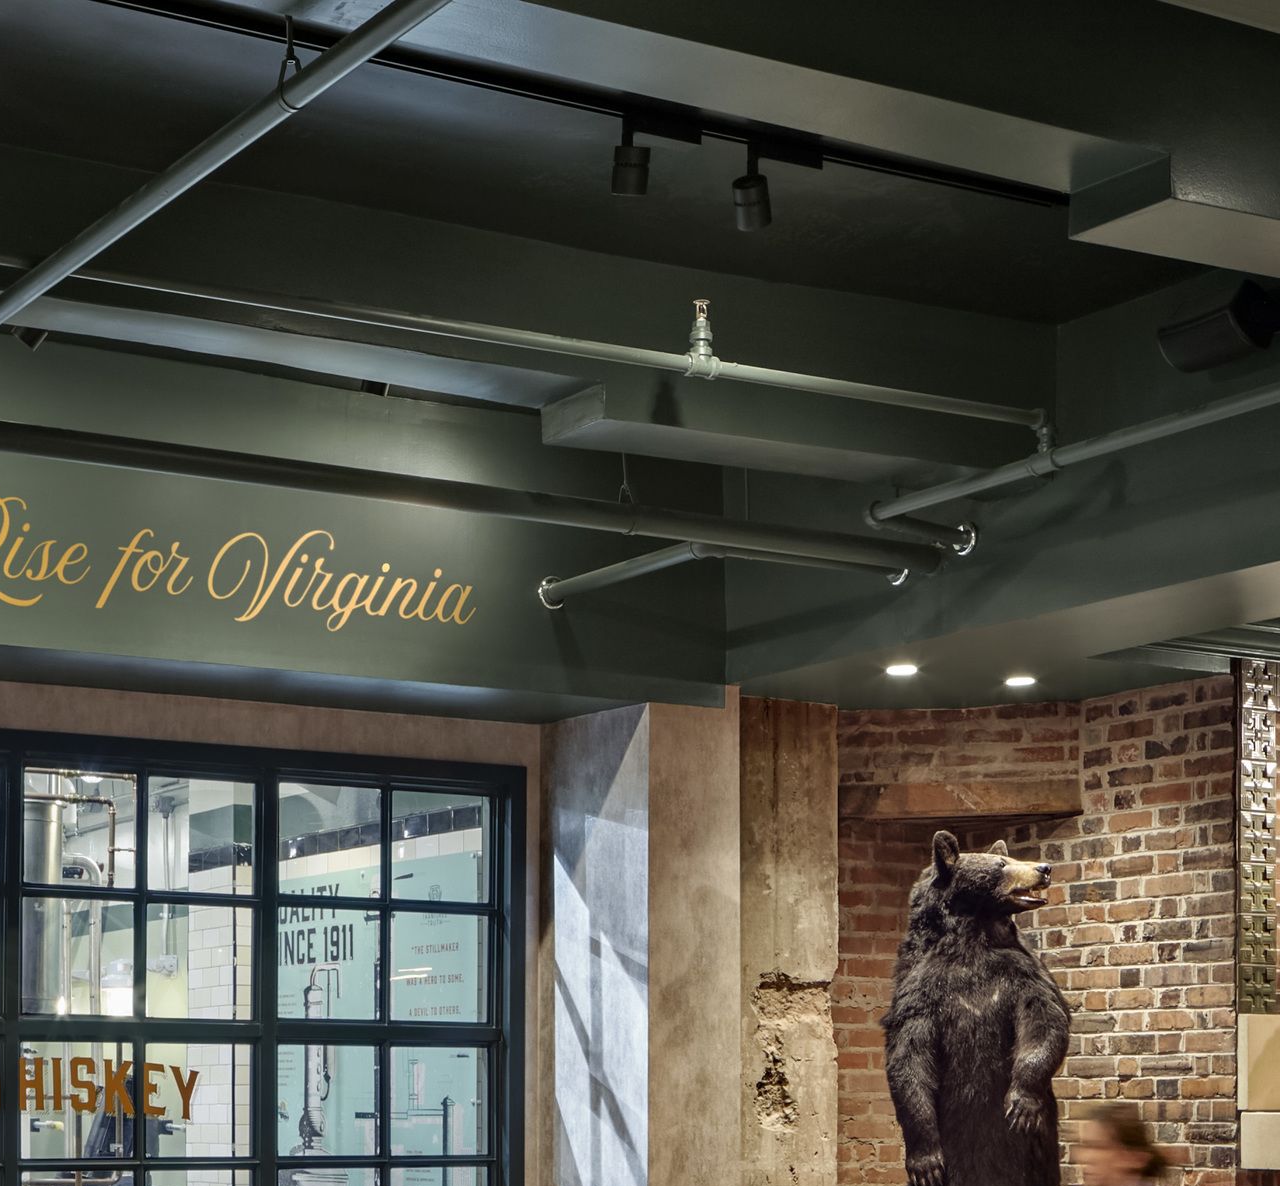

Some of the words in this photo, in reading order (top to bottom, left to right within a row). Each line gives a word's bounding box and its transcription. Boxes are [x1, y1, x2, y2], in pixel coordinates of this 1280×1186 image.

[95, 529, 194, 609] for
[207, 530, 477, 632] Virginia
[277, 883, 340, 925] UALITY
[277, 928, 317, 967] INCE
[323, 924, 354, 963] 1911
